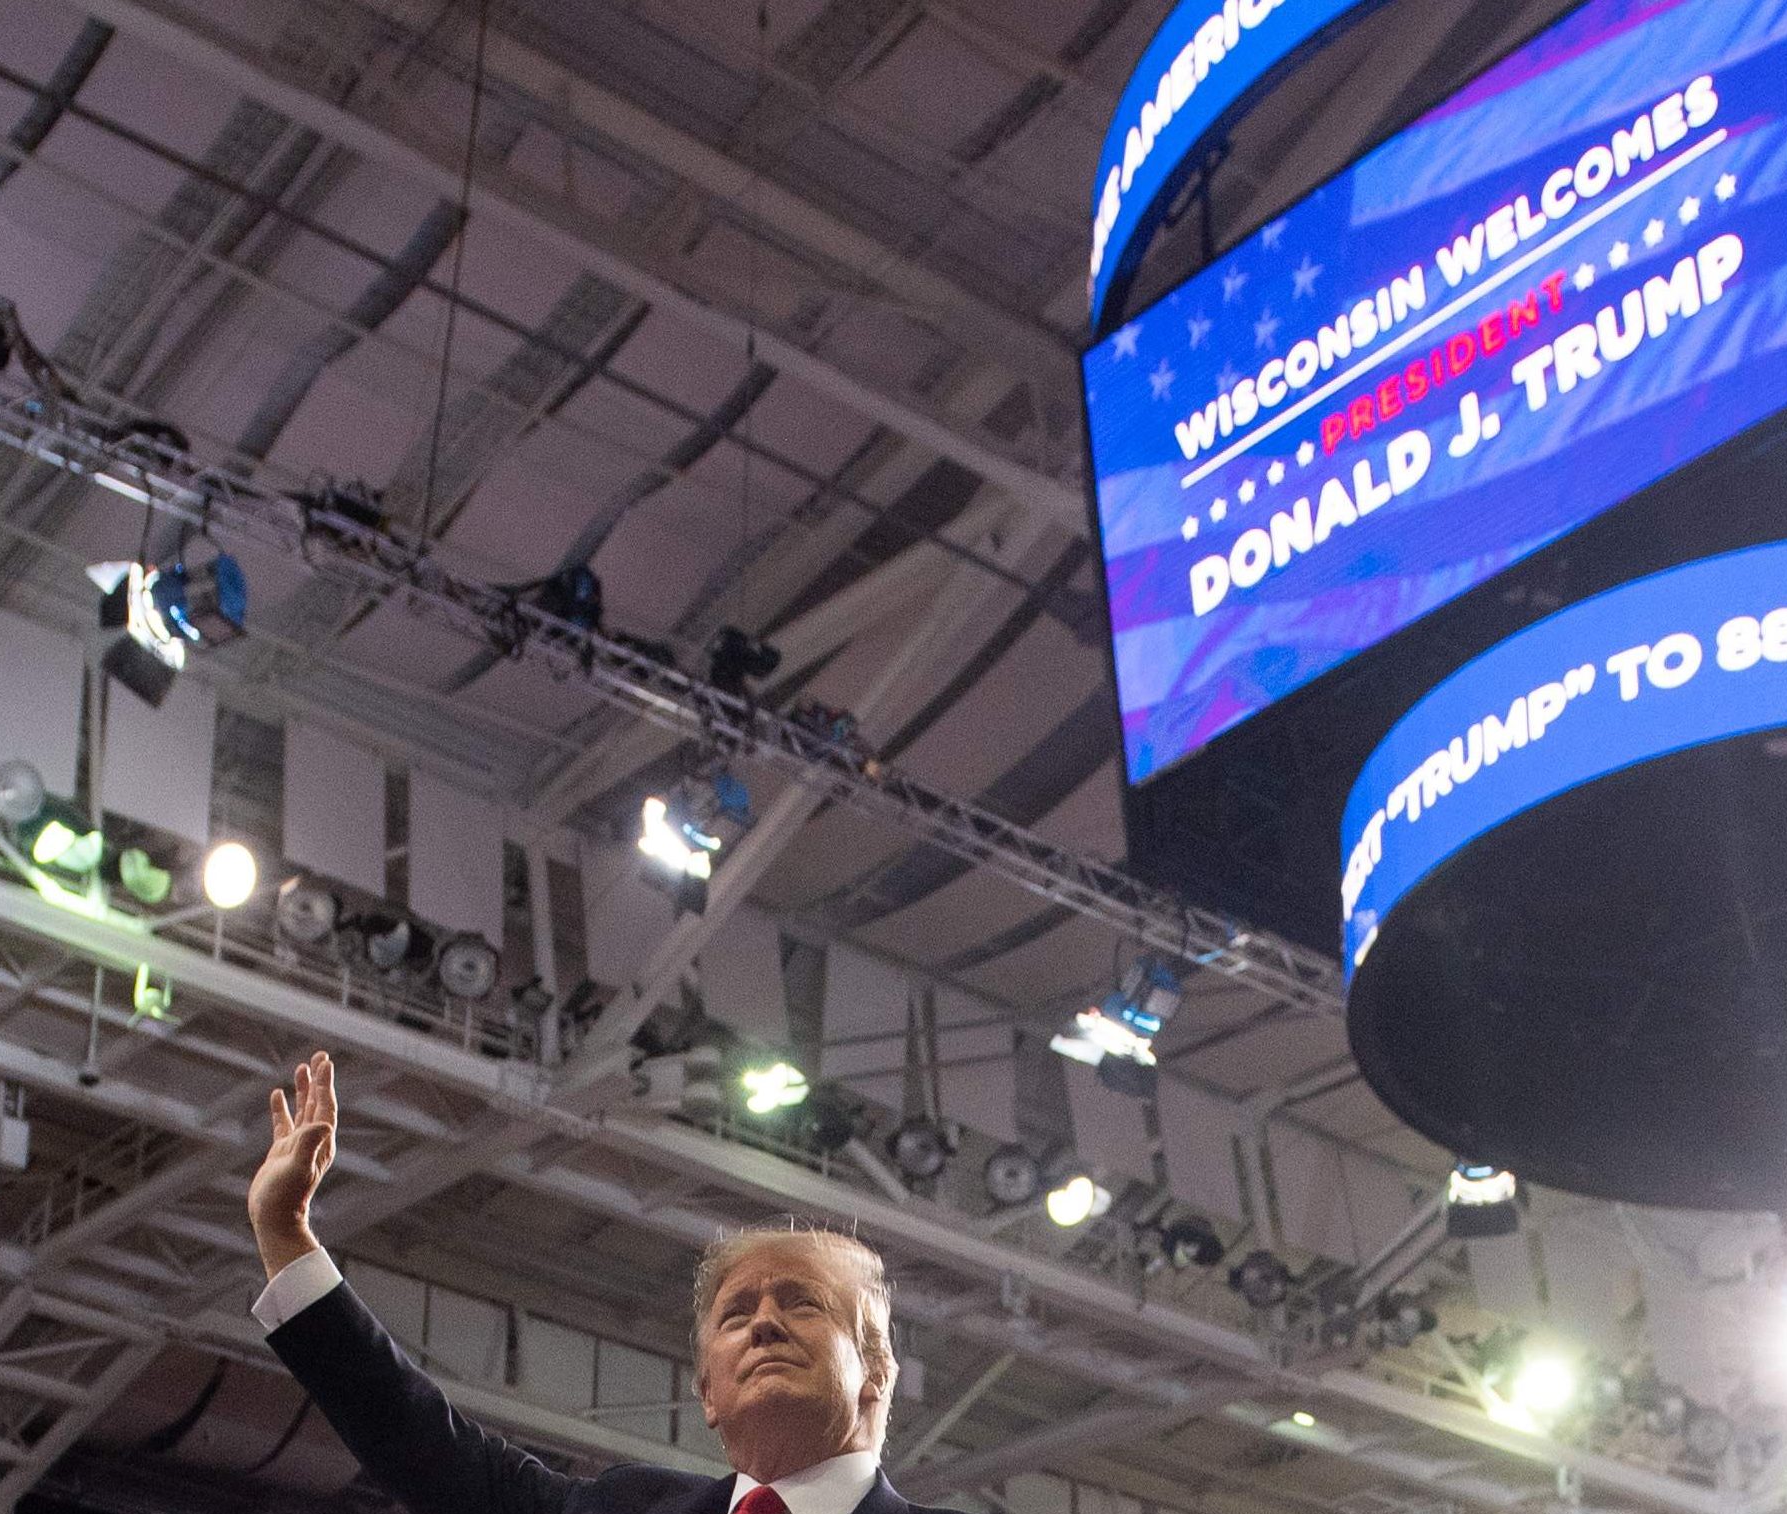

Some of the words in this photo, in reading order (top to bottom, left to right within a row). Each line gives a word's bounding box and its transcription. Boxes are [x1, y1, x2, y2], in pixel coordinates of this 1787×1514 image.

[1175, 266, 1427, 460] WISCONSIN
[1436, 75, 1719, 287] WELCOMES
[1320, 270, 1569, 457] PRESIDENT
[1188, 428, 1432, 617] DONALD
[1447, 391, 1502, 457] J.
[1512, 233, 1744, 412] TRUMP
[1606, 633, 1703, 702] TO
